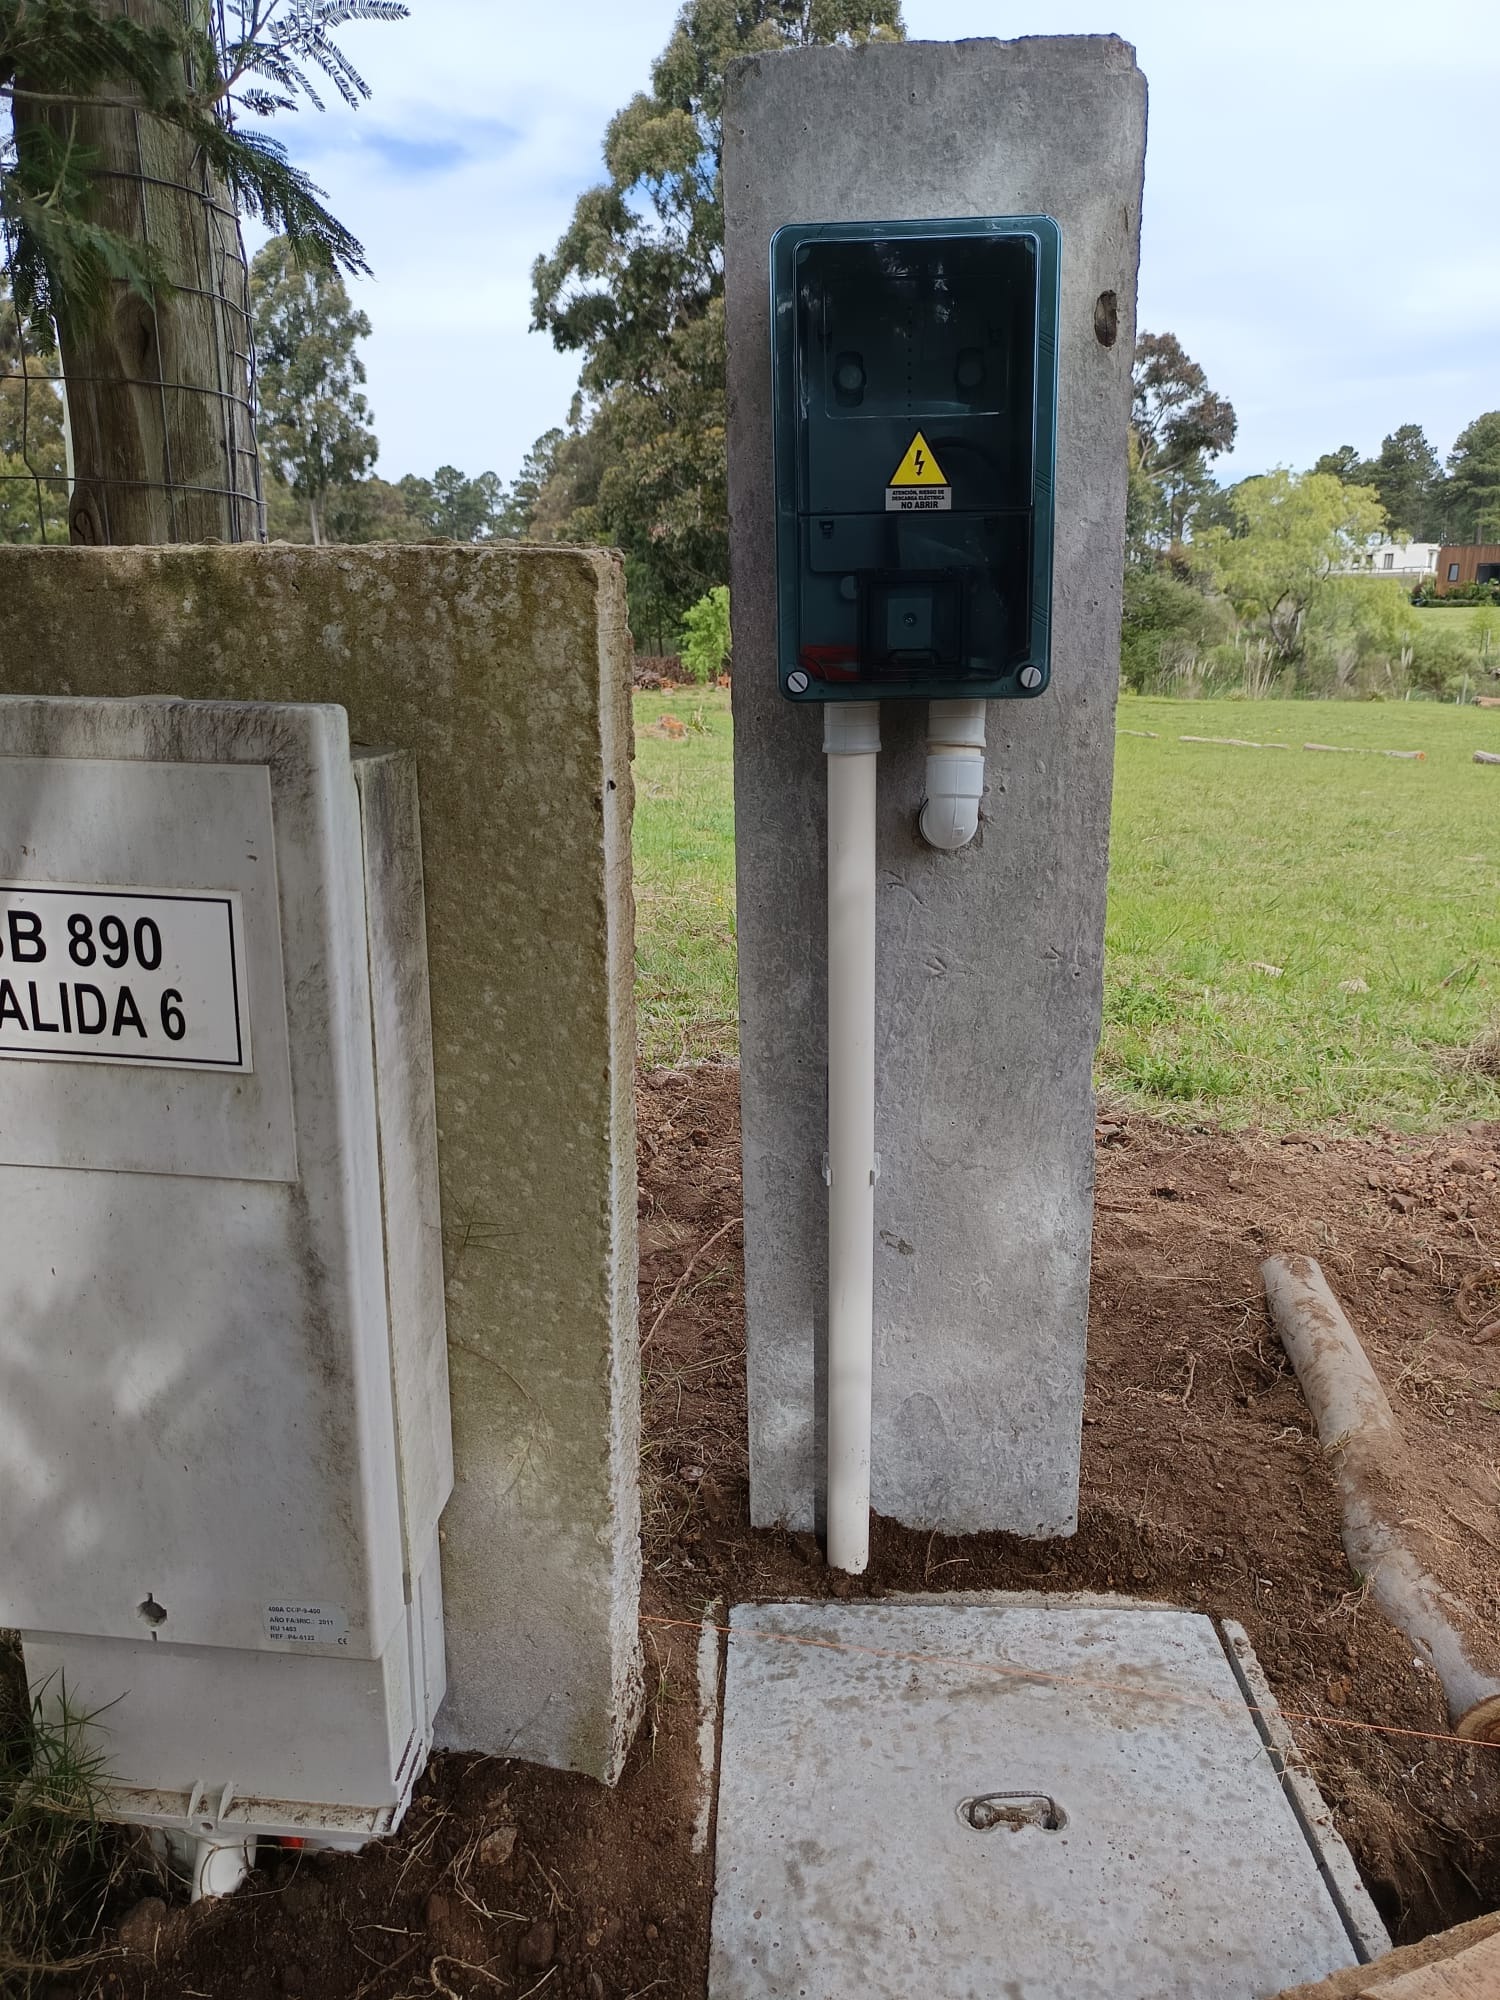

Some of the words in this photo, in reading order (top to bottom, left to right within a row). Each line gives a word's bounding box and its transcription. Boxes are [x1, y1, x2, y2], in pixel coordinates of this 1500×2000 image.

[901, 501, 912, 509] NO
[915, 501, 938, 509] ABRIR
[0, 910, 47, 964] B
[67, 913, 163, 971] 890
[160, 988, 187, 1041] 6
